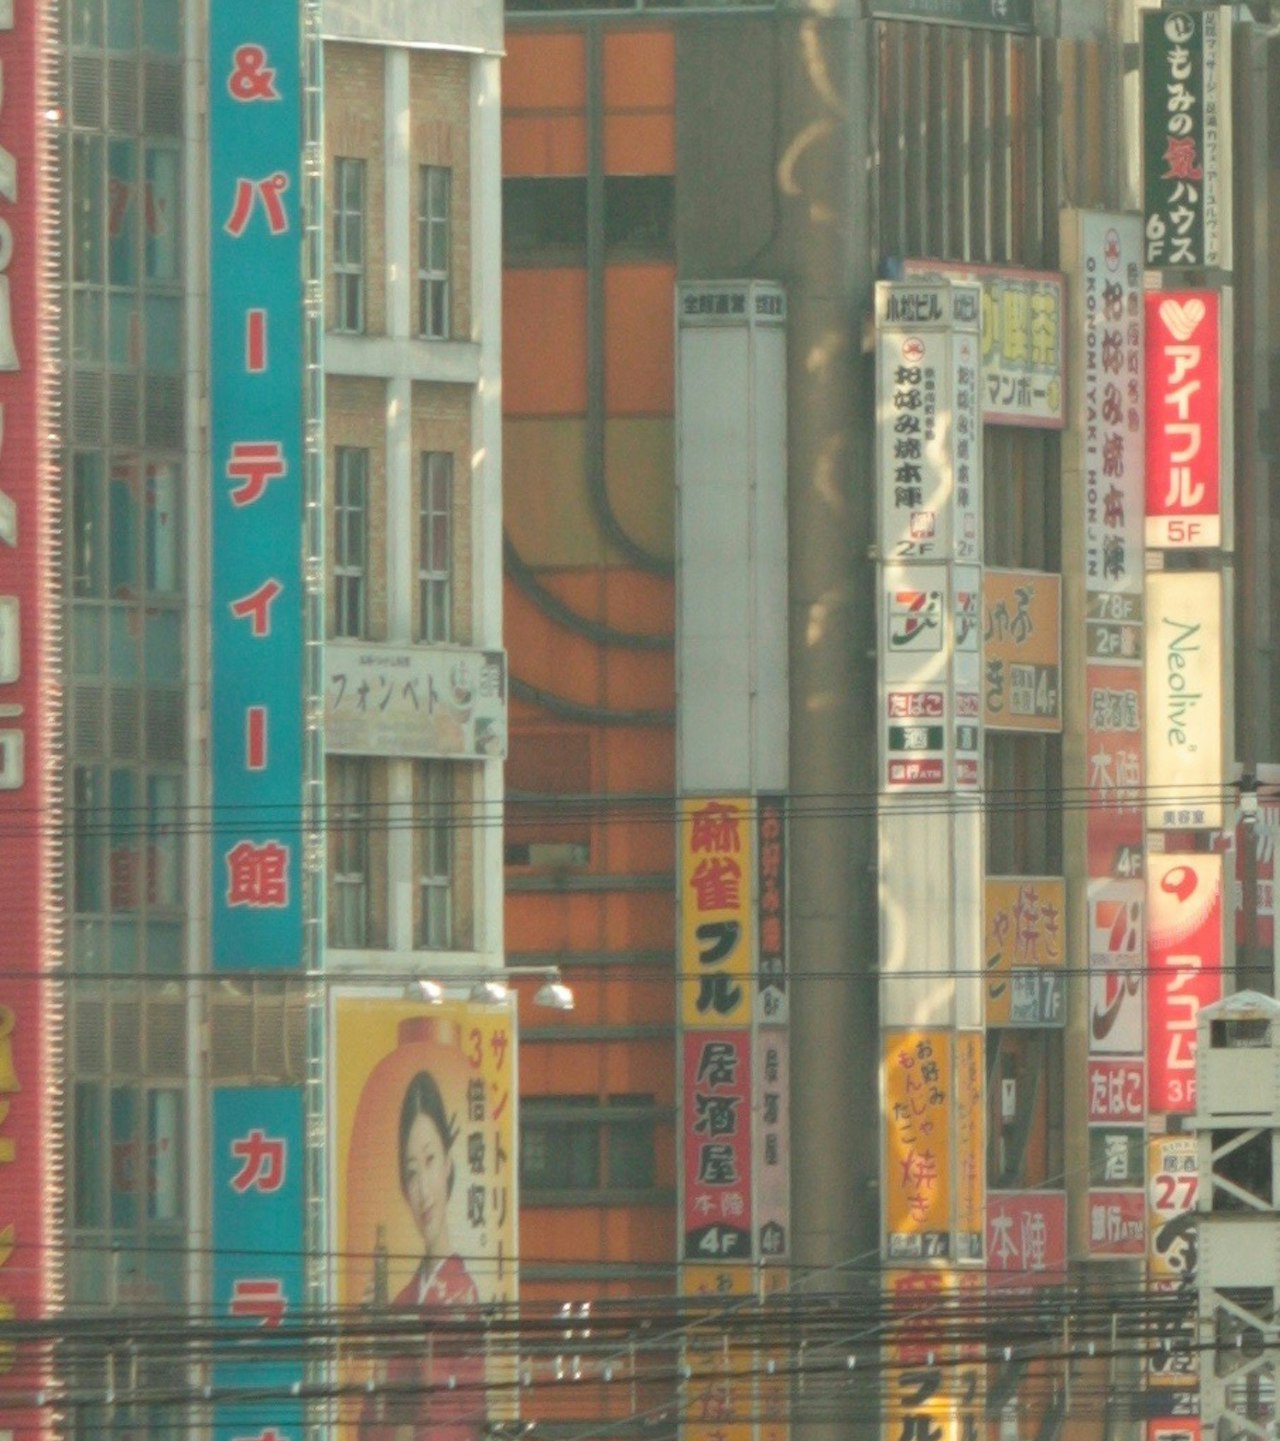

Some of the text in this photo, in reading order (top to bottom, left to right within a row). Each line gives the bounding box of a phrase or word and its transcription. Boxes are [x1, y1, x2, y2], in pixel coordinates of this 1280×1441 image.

[1163, 345, 1206, 508] アイフル
[897, 541, 936, 557] 2F
[1167, 521, 1202, 542] 5F
[1162, 616, 1202, 748] Neolive
[1164, 954, 1202, 1069] アコム
[695, 1042, 739, 1186] 居酒屋
[1089, 1067, 1143, 1115] たばこ
[1104, 1134, 1130, 1181] 酒
[700, 1226, 739, 1255] 4F
